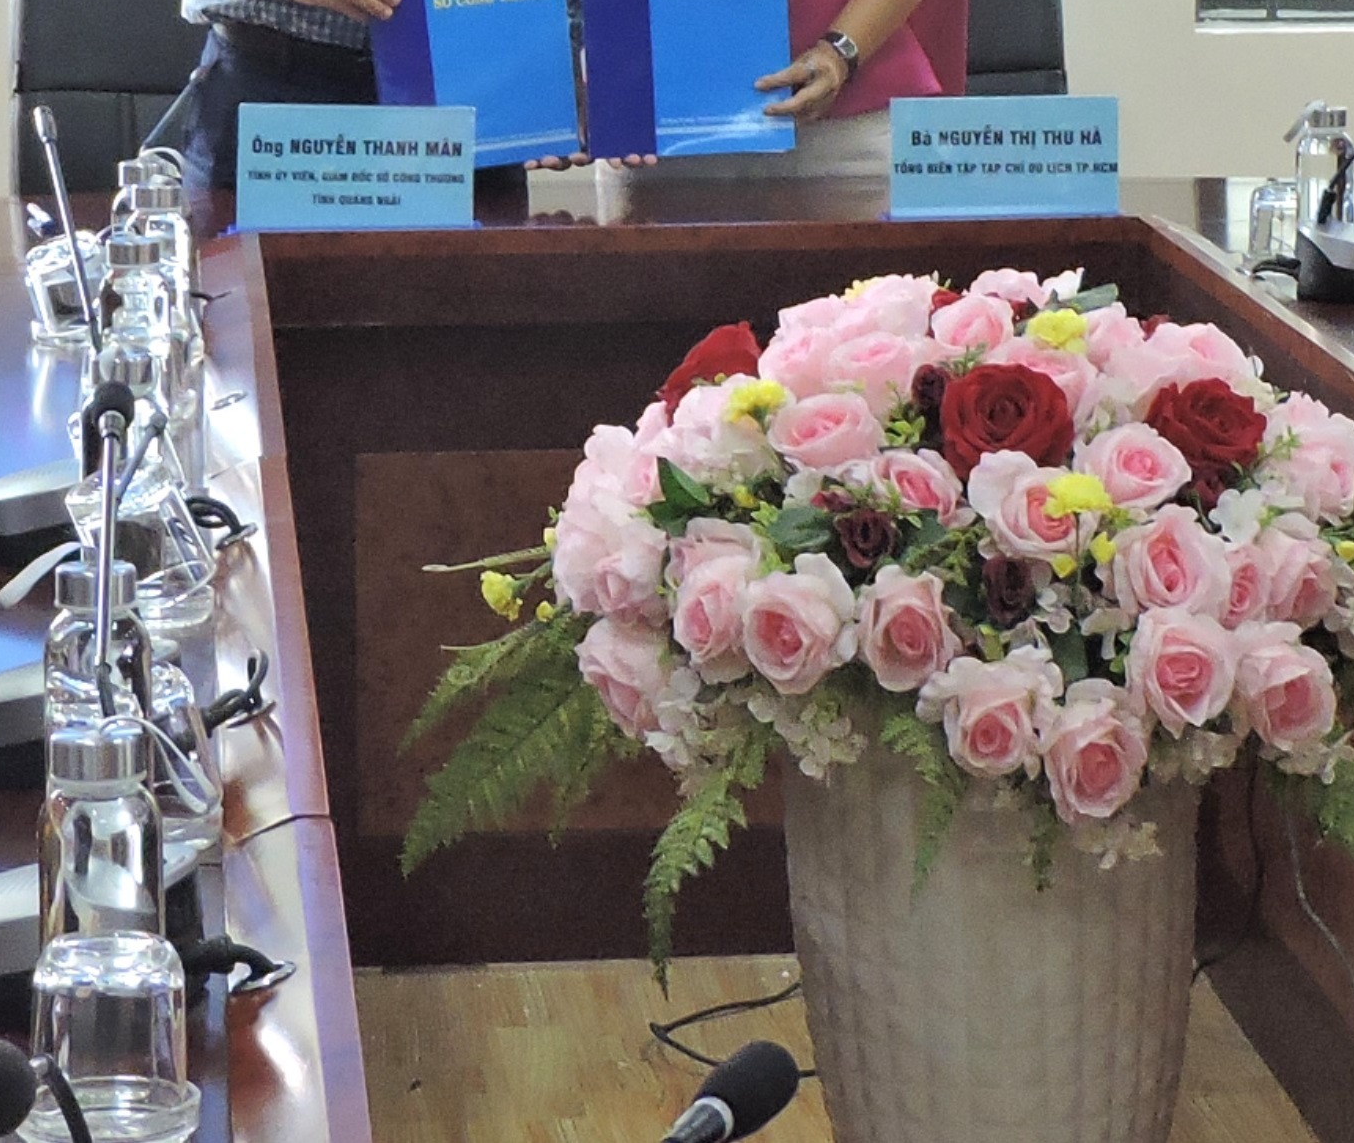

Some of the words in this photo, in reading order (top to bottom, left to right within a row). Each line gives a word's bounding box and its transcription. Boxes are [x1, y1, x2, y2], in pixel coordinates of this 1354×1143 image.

[252, 134, 284, 158] Ông
[363, 140, 419, 156] THANH
[911, 130, 932, 146] Bà
[1010, 130, 1036, 149] THỊ
[1042, 130, 1075, 145] THU
